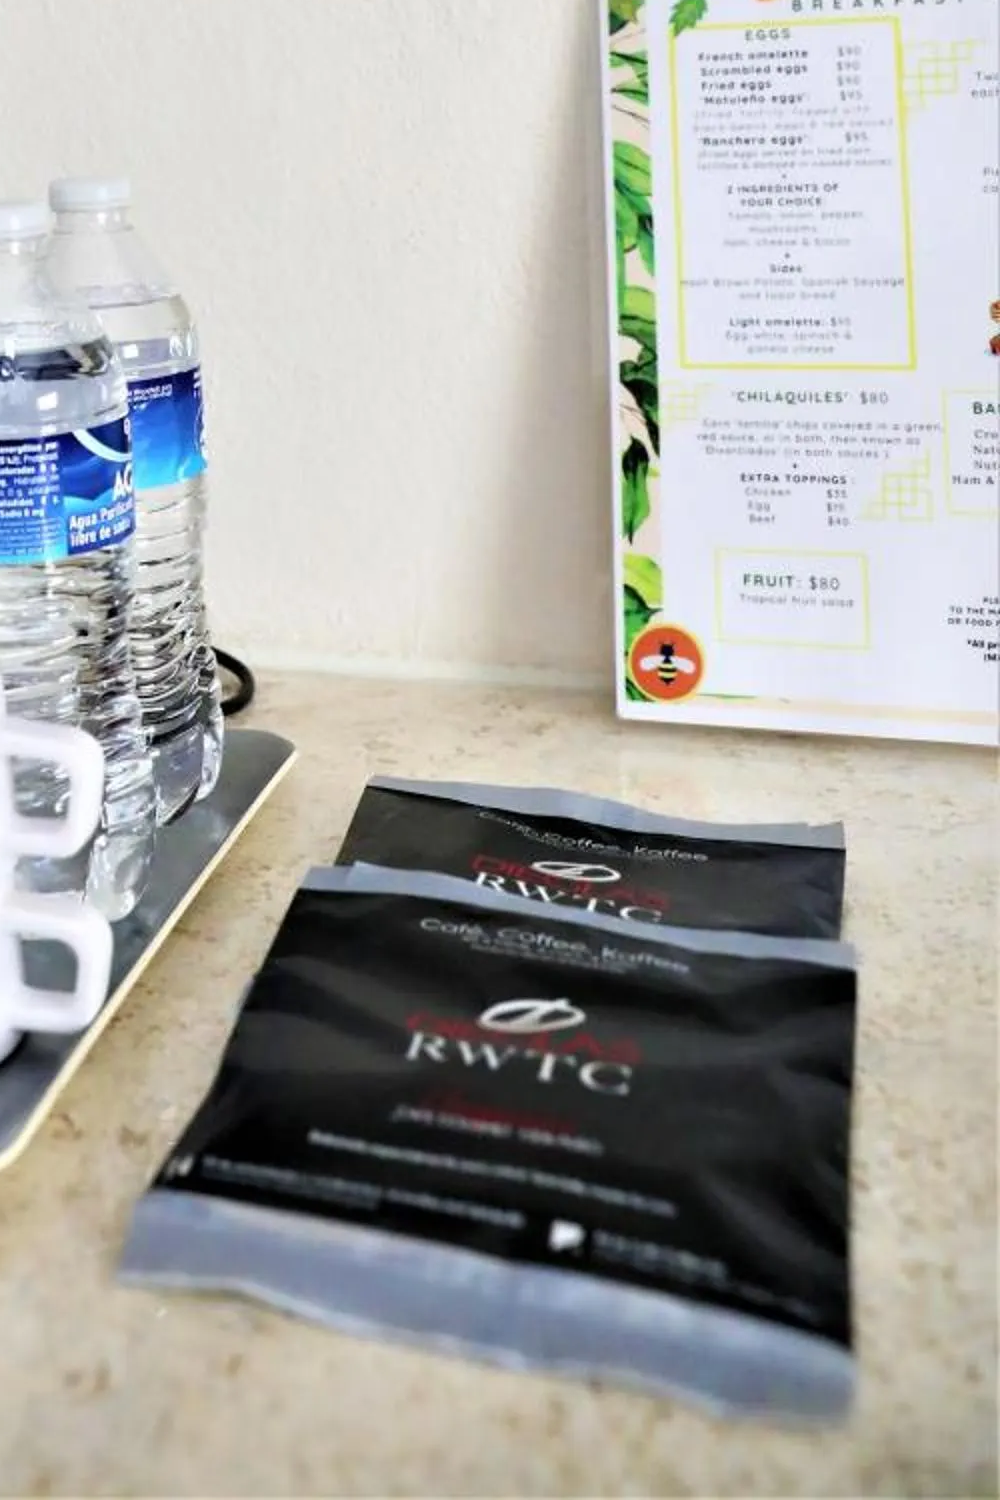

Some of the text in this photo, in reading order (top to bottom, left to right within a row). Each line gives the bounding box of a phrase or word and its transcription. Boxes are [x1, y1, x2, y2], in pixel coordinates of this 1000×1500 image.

[744, 28, 792, 42] EGGS
[700, 64, 772, 77] Scrambled
[776, 63, 808, 76] eggs
[701, 81, 736, 92] Fried
[740, 81, 773, 93] eggs
[737, 181, 820, 194] INGREDIENTS
[823, 180, 841, 193] OF
[740, 196, 773, 208] YOUR
[859, 390, 890, 406] $80
[739, 472, 848, 486] EXTRA TOPPINGS
[952, 475, 981, 485] Ham
[69, 512, 97, 531] Agua
[69, 530, 97, 547] libre
[99, 524, 111, 541] de
[808, 574, 842, 592] $80
[403, 1029, 634, 1098] RWTC
